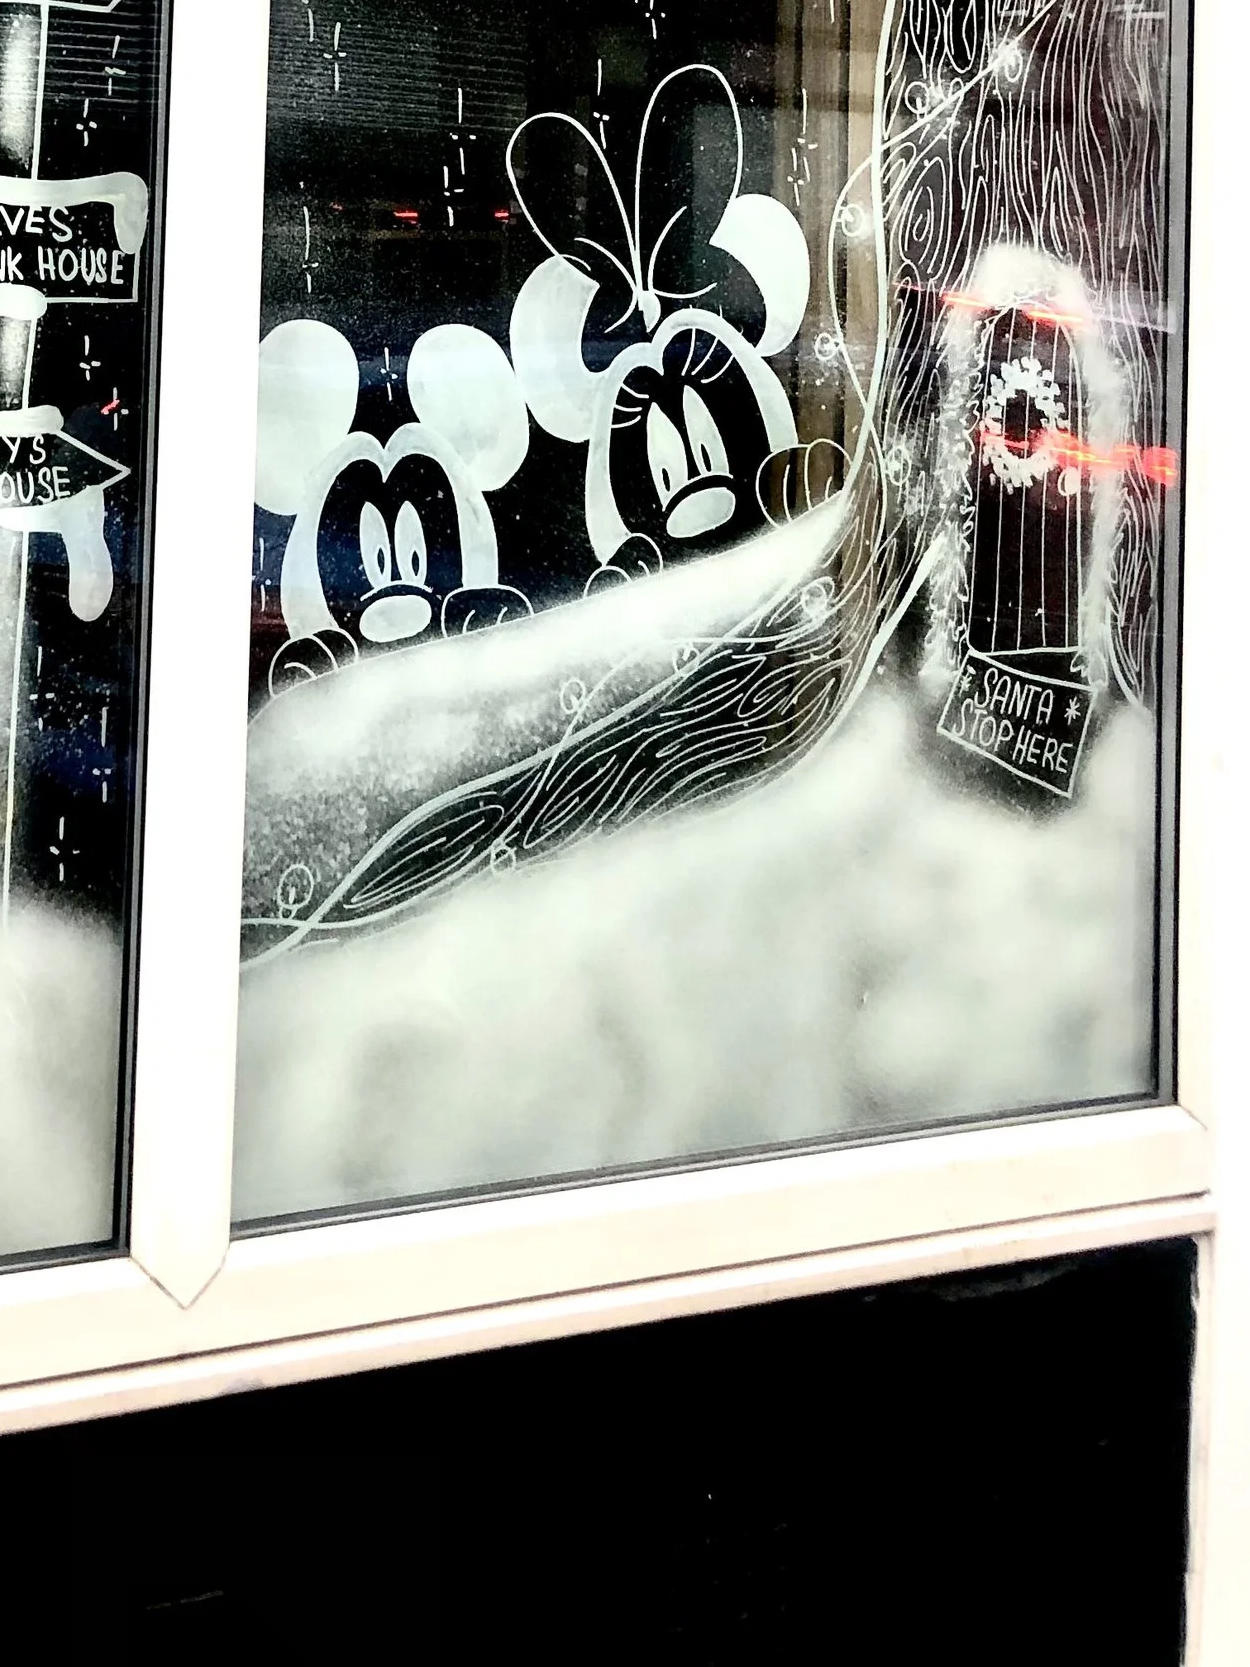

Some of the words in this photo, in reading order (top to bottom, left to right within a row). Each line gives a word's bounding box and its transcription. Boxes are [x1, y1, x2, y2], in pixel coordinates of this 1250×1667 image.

[38, 247, 124, 285] HOUSE
[975, 667, 1054, 724] SANTA
[953, 698, 1013, 752] STOP
[1013, 725, 1073, 773] HERE
